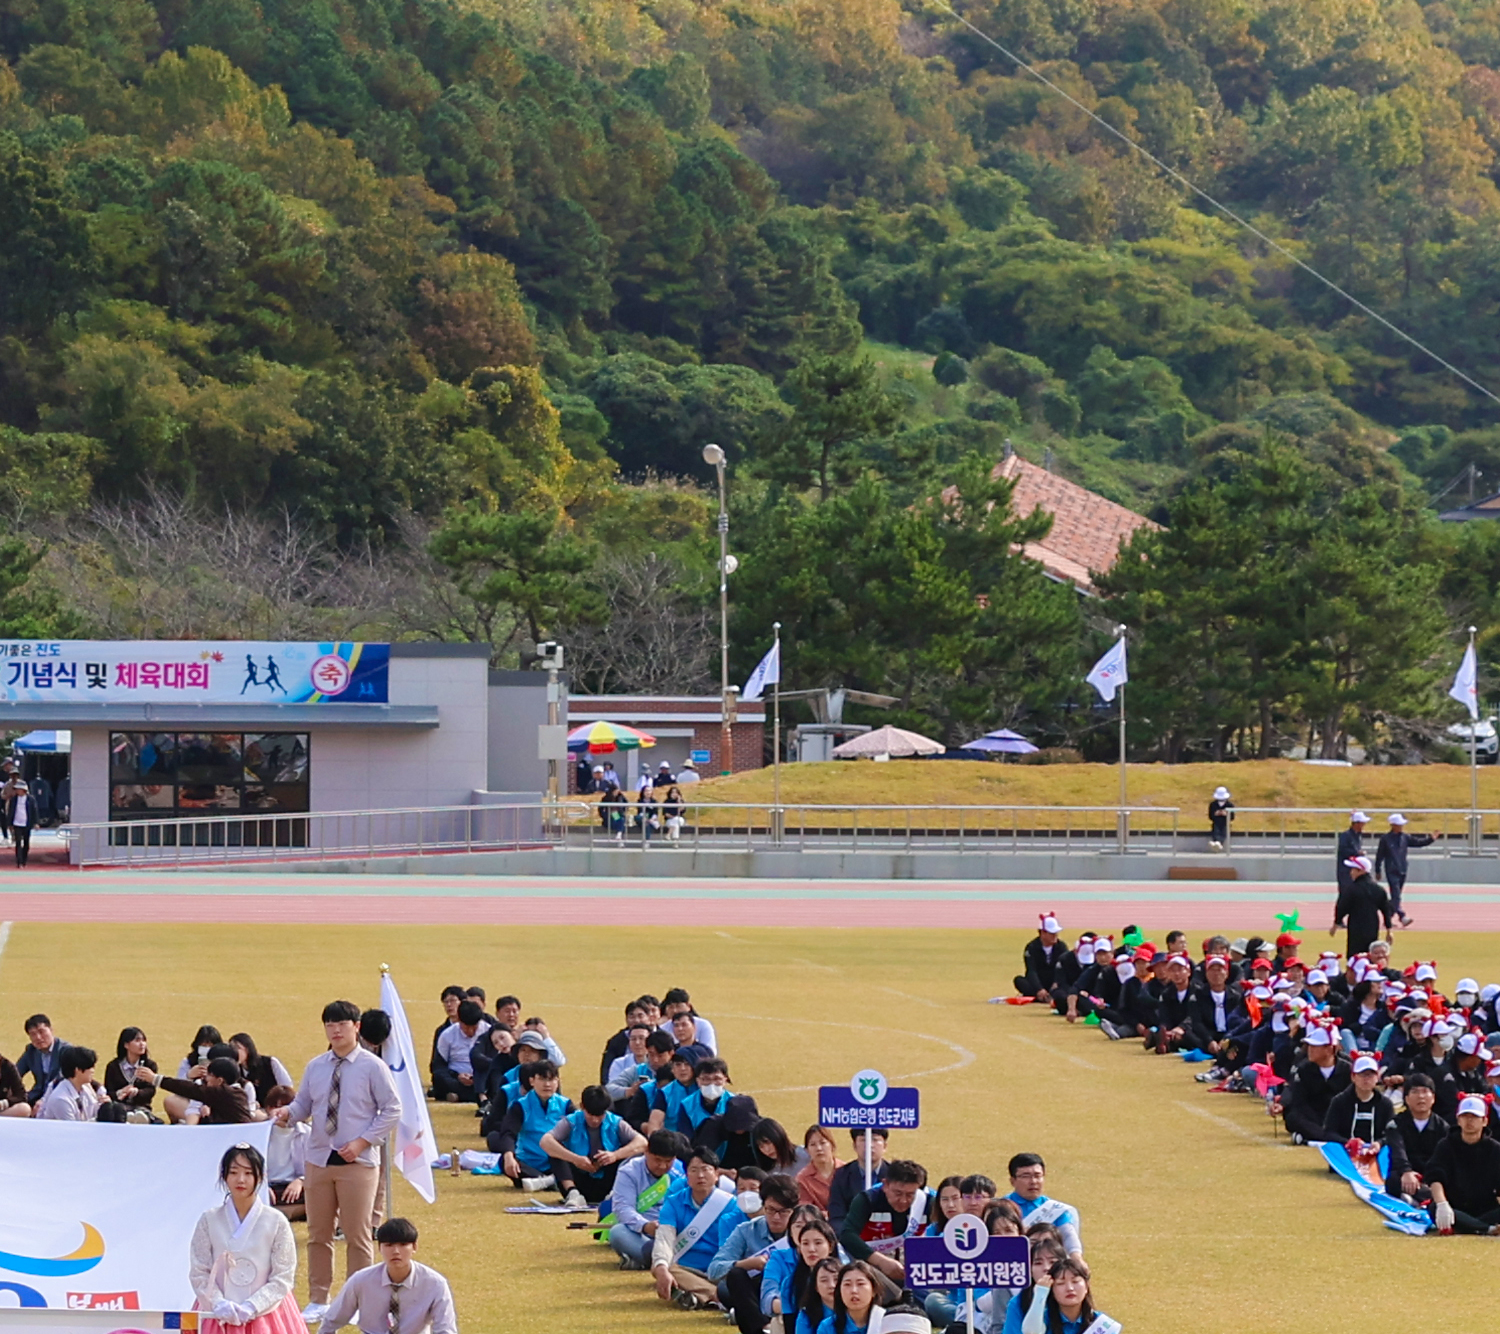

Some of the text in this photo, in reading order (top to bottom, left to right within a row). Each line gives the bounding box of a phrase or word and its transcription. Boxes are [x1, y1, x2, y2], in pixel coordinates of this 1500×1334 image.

[36, 643, 61, 656] 진도
[8, 661, 76, 689] 기념식
[86, 662, 107, 689] 및
[114, 661, 209, 689] 체육대회
[319, 662, 343, 686] 축
[822, 1107, 916, 1126] NH농협은행 진도군지부
[910, 1261, 1026, 1287] 진도교육지원청
